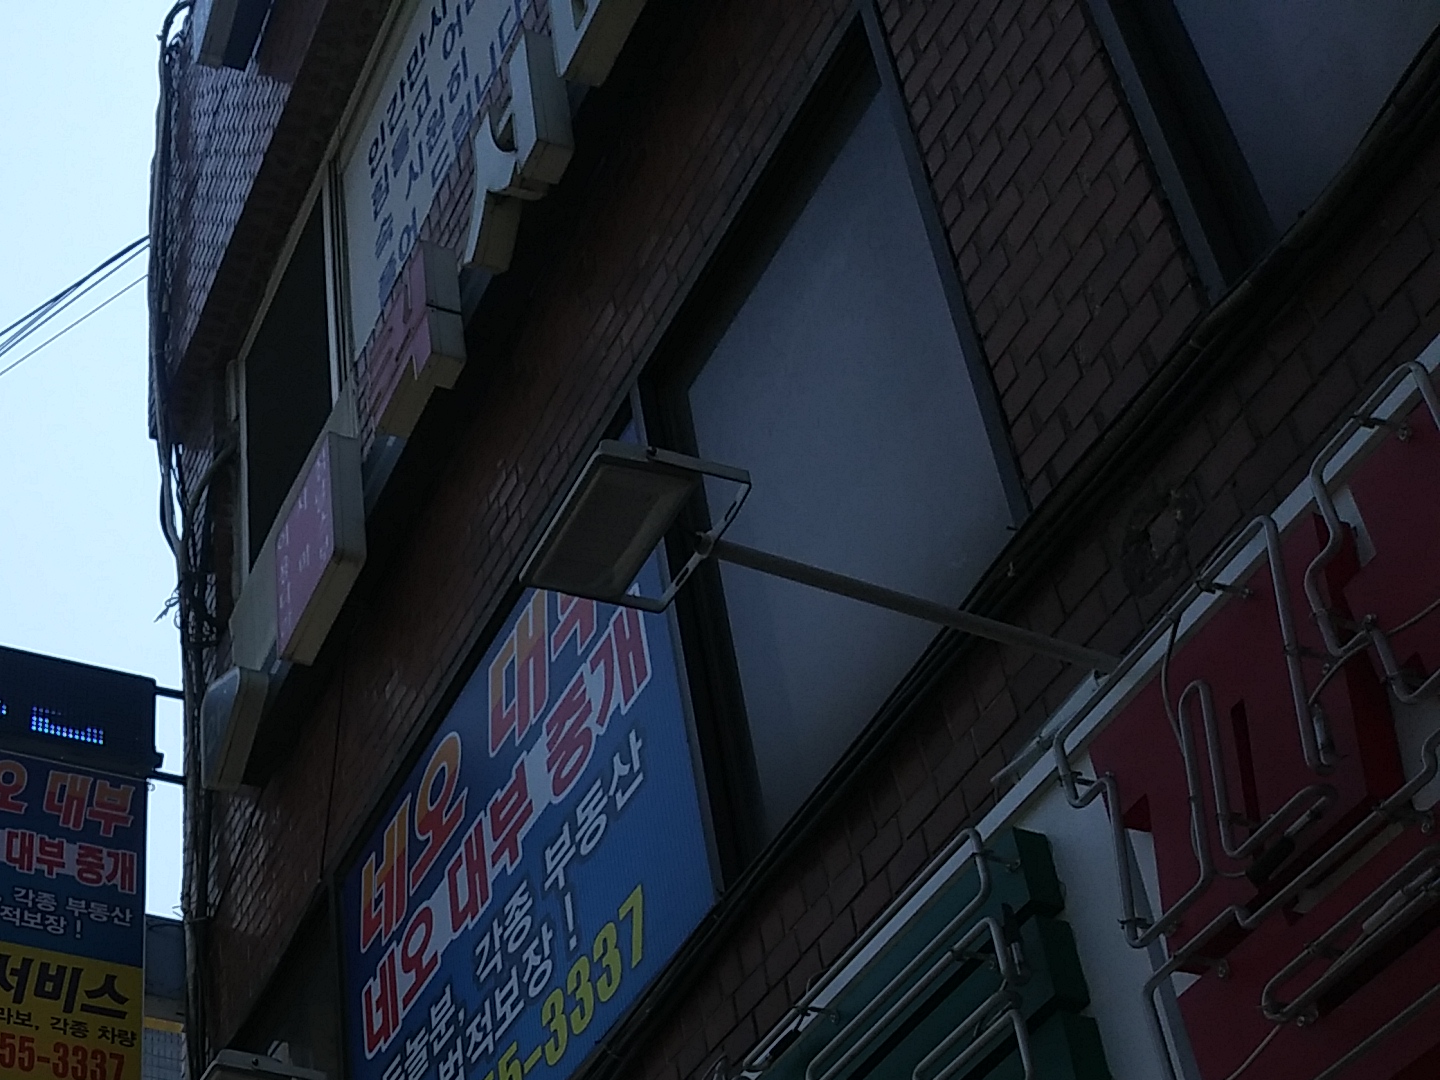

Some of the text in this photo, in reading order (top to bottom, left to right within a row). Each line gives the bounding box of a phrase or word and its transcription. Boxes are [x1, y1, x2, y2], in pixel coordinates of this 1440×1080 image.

[43, 769, 135, 838] 대부
[362, 583, 652, 1061] 네오 대부 중개
[4, 827, 66, 879] 대부
[75, 842, 137, 895] 중개
[361, 731, 467, 953] 네오
[475, 880, 534, 983] 각종
[544, 728, 643, 893] 부동산
[13, 885, 58, 912] 각종
[66, 896, 134, 928] 부동산
[50, 1016, 89, 1039] 각종
[98, 1025, 138, 1048] 차량
